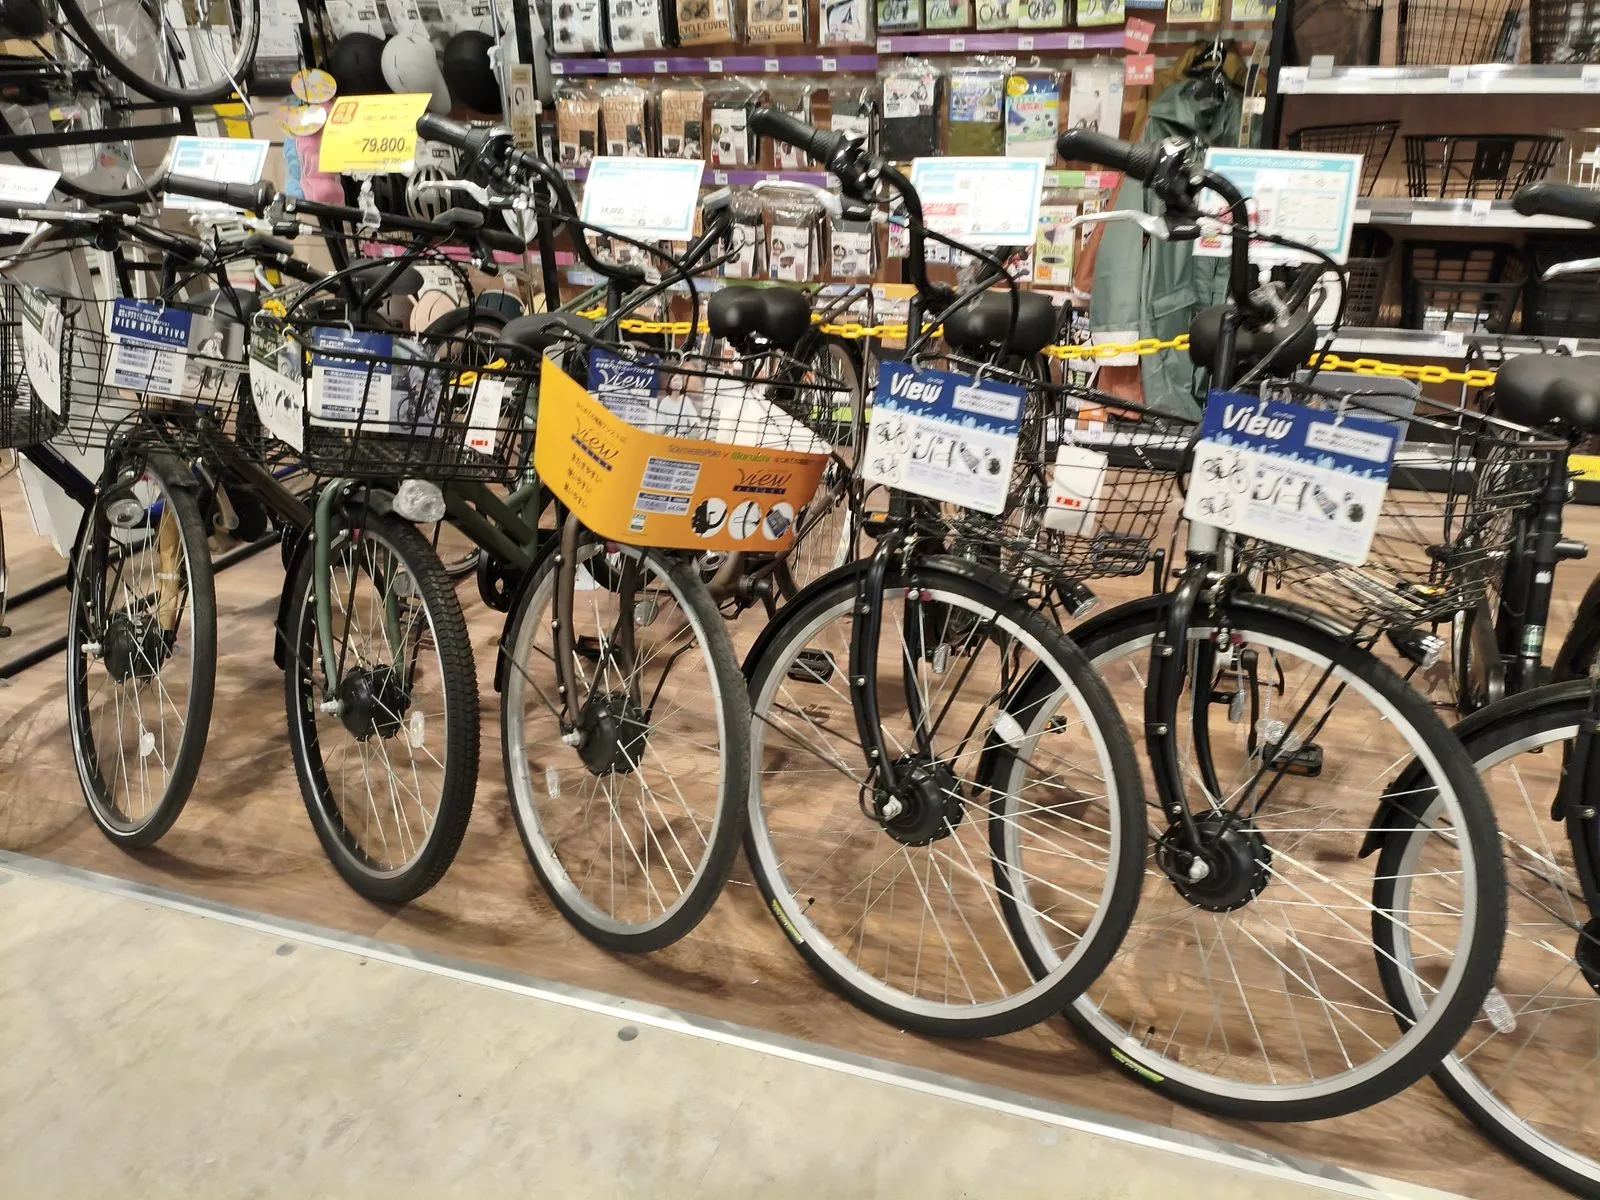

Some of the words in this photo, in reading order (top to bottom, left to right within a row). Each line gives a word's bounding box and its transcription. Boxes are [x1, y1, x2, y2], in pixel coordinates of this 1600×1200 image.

[680, 23, 701, 33] CYCLE
[703, 20, 728, 31] COVER
[750, 25, 772, 35] CYCLE
[775, 23, 801, 33] COVER
[114, 316, 137, 330] VIEW
[140, 321, 187, 340] SPORTIVO
[599, 370, 653, 389] View
[890, 371, 943, 404] View
[1221, 403, 1294, 440] View
[575, 416, 620, 461] View
[738, 468, 792, 487] View
